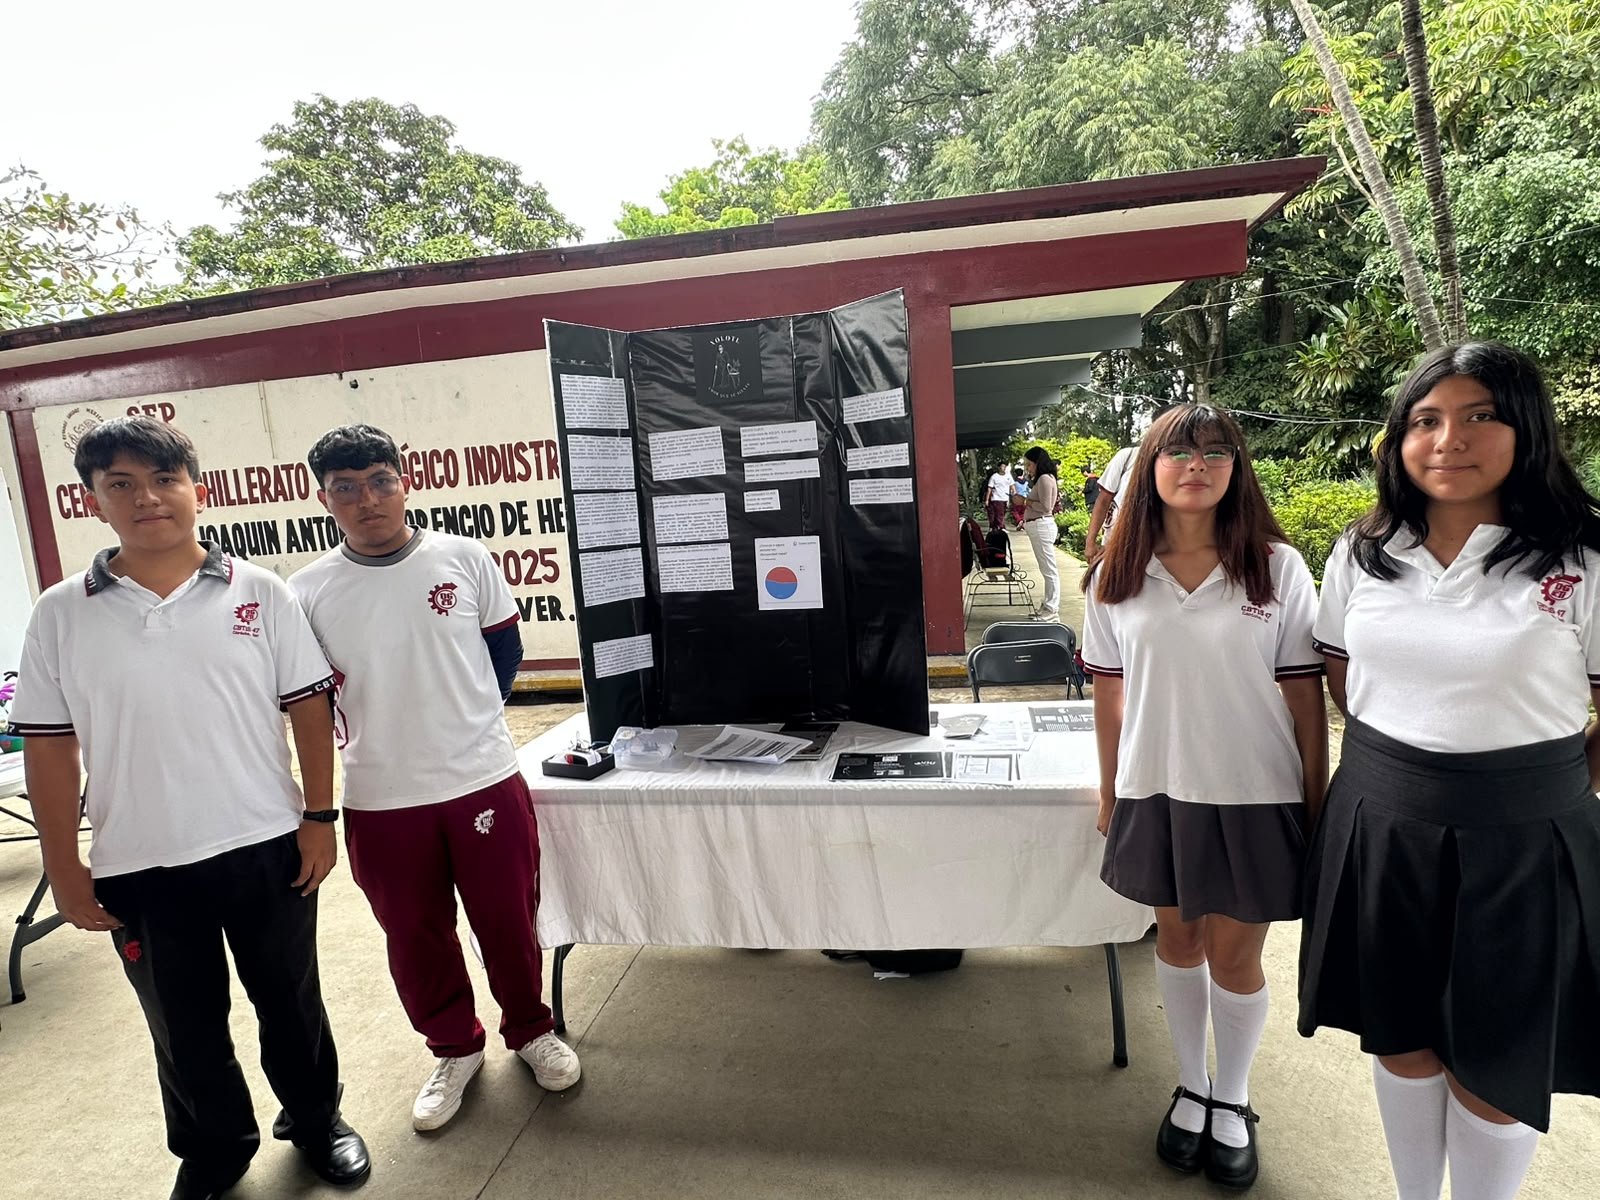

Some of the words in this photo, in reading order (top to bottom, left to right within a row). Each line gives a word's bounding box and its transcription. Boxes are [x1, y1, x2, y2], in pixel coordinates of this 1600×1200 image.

[199, 462, 310, 508] HILLERATO
[287, 515, 346, 554] ANTO
[500, 500, 532, 537] DE
[489, 547, 560, 587] 025
[515, 594, 576, 622] VER.
